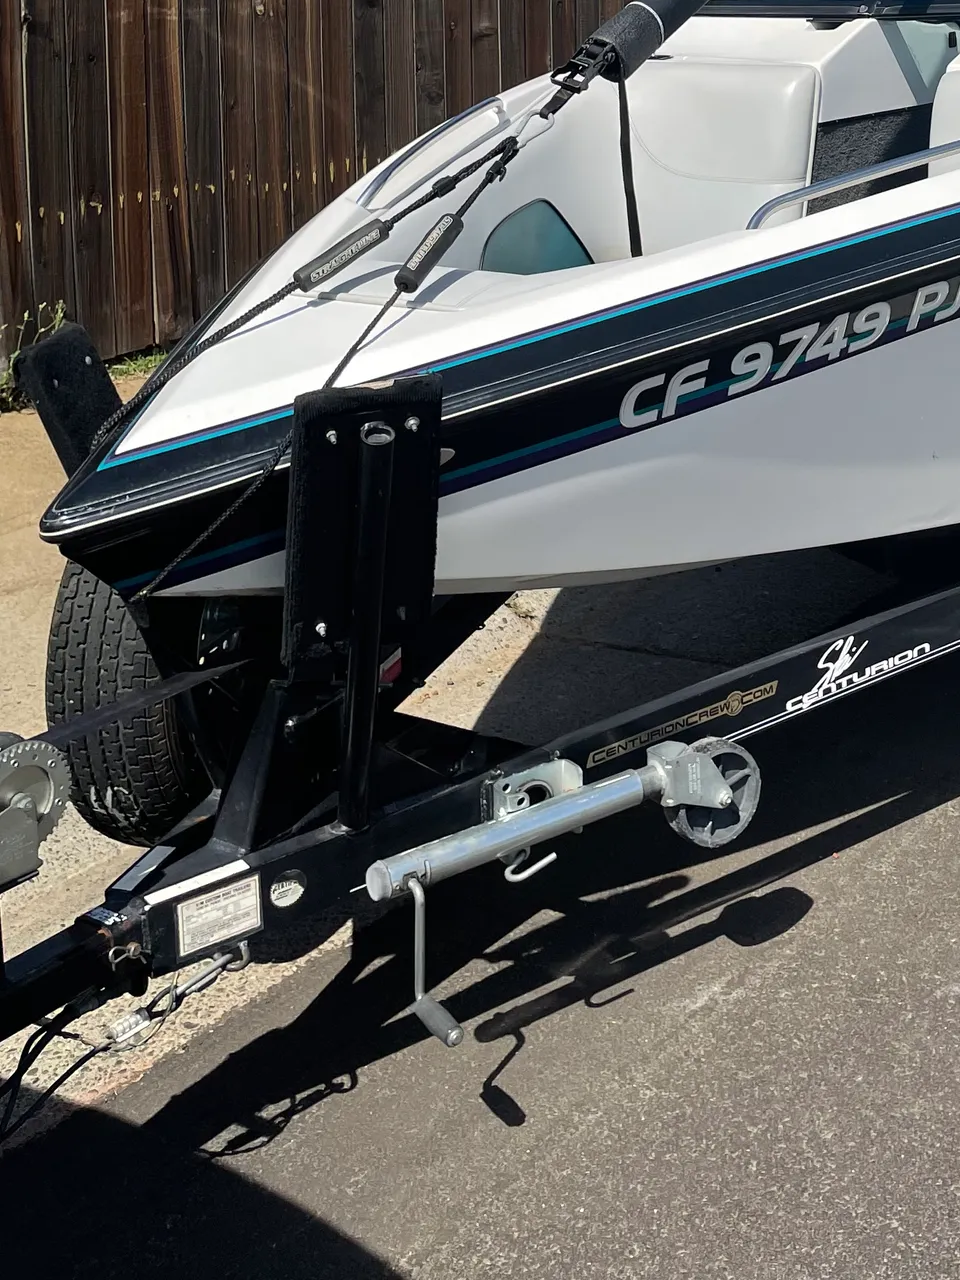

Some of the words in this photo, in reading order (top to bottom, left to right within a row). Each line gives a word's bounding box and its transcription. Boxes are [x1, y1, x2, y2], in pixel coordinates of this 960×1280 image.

[619, 358, 710, 428] CF
[727, 302, 891, 396] 9749
[786, 642, 931, 712] CENTURION
